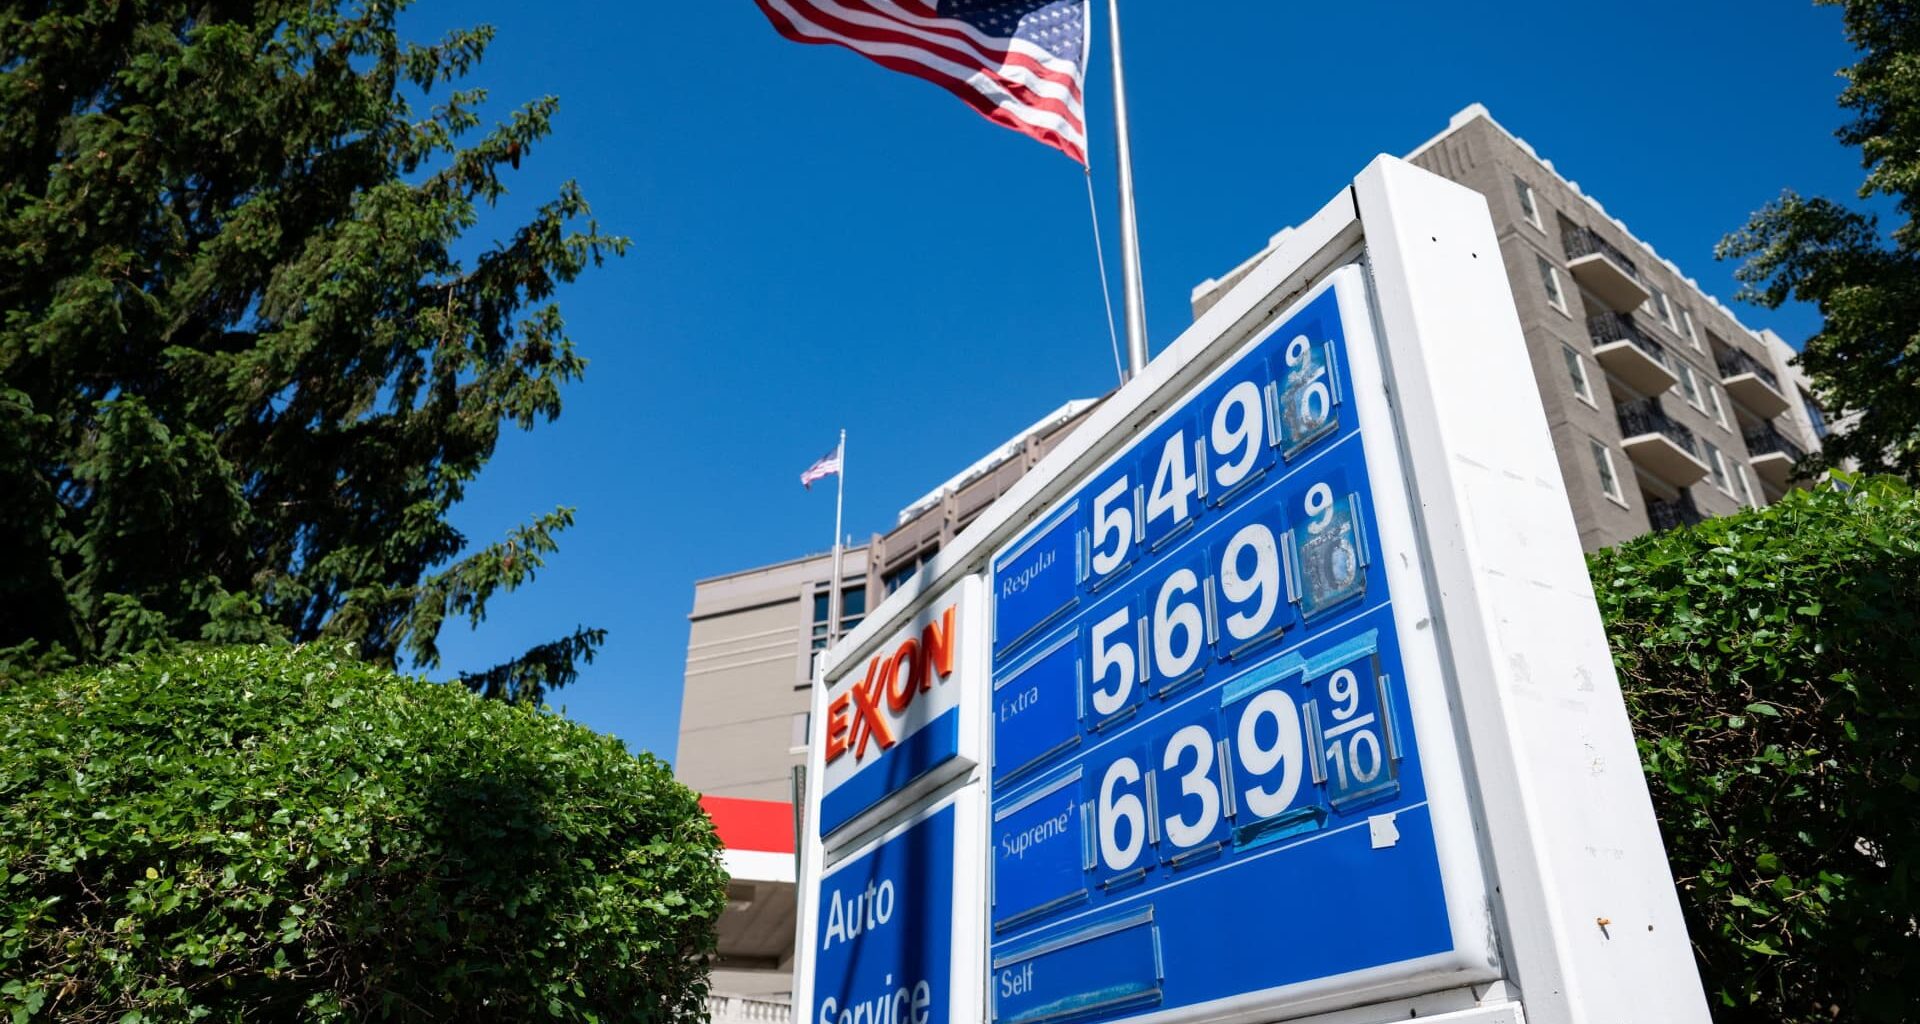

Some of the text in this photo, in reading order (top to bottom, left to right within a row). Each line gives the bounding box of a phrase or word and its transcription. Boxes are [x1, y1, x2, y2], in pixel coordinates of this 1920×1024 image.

[1092, 381, 1263, 576] 549
[1304, 482, 1333, 534] 9
[1002, 549, 1056, 600] Regular
[1092, 524, 1280, 715] 569
[825, 603, 957, 766] EXXON
[1001, 686, 1038, 723] Extra
[1328, 668, 1359, 721] 9
[1099, 689, 1304, 871] 639
[1326, 729, 1382, 791] 10
[823, 878, 895, 951] Auto
[1001, 962, 1034, 998] Self
